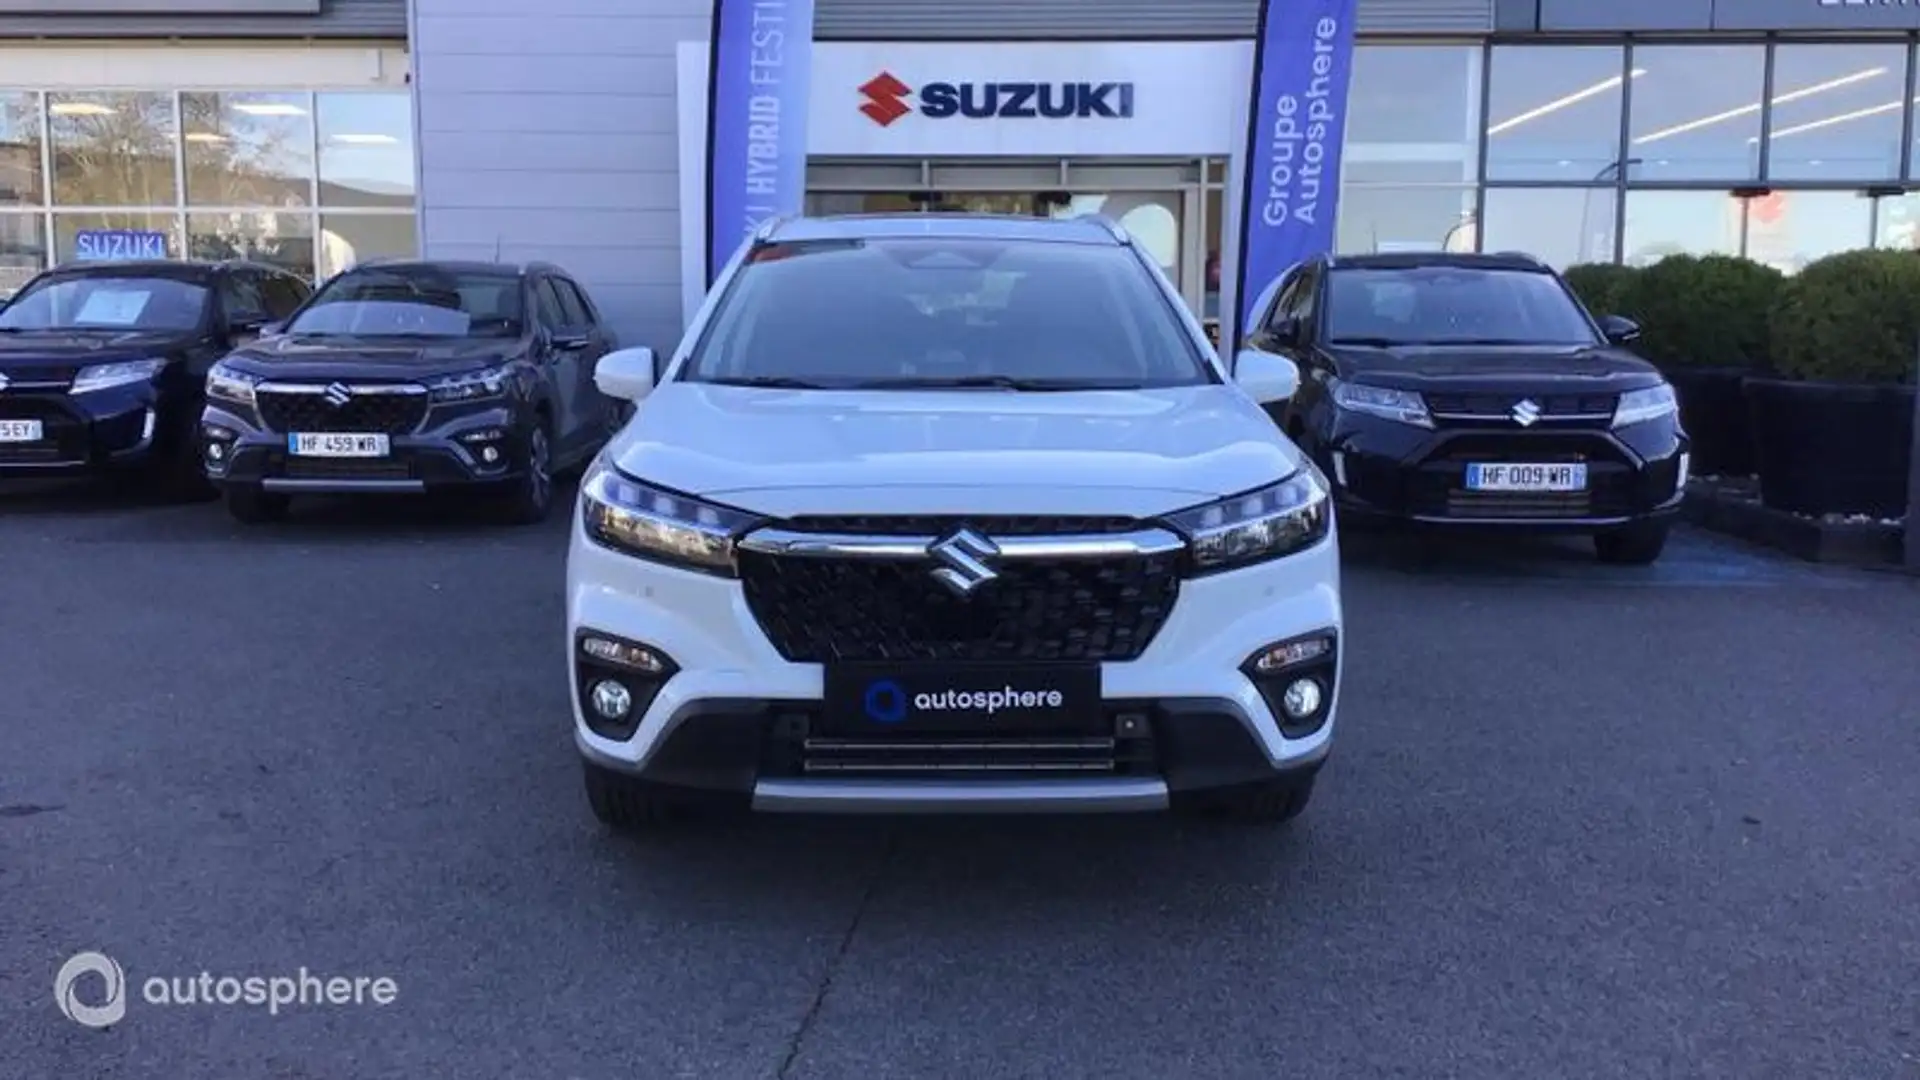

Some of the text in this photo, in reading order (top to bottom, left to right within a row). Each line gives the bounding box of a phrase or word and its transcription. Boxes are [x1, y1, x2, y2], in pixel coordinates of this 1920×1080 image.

[920, 82, 1134, 119] SUZUKI
[1294, 16, 1337, 225] Autosphere
[746, 96, 780, 194] HYBRID
[1262, 94, 1304, 227] Groupe
[78, 234, 163, 260] SUZUKI
[914, 685, 1063, 714] autosphere
